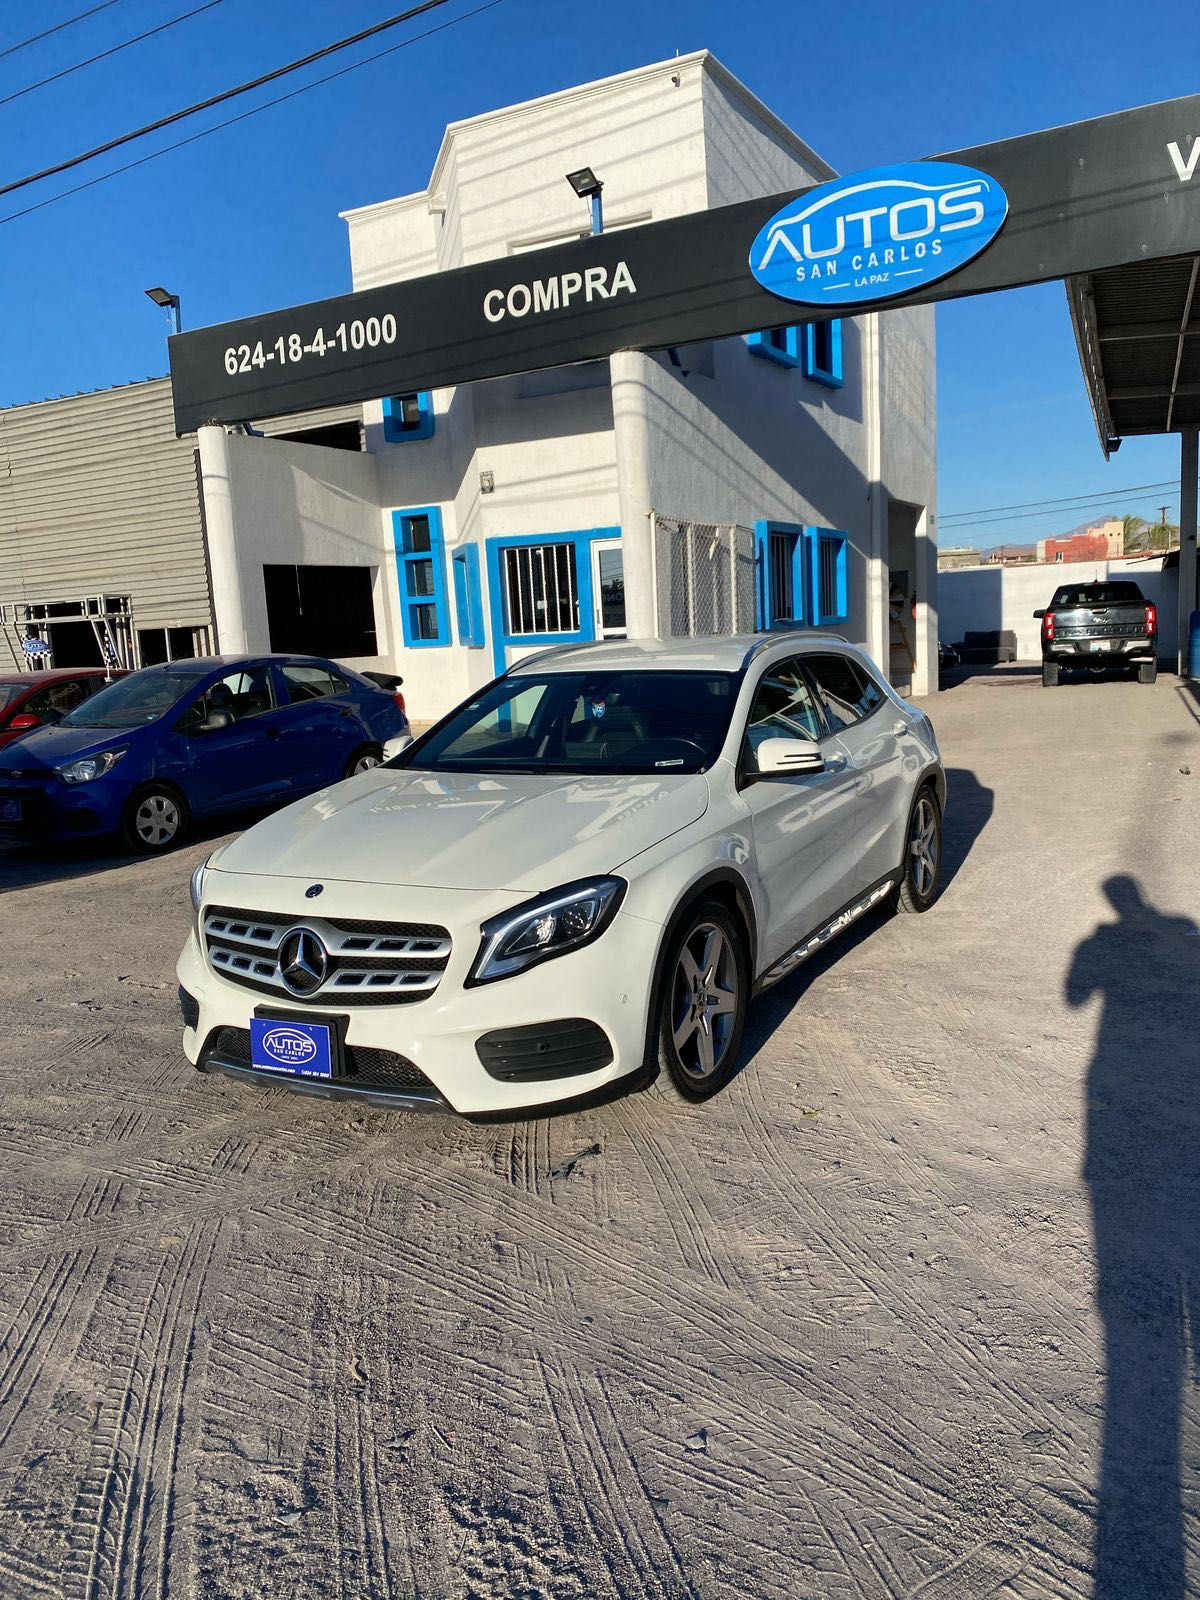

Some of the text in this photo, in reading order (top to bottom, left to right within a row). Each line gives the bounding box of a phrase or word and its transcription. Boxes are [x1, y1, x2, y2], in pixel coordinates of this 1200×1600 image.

[1167, 136, 1200, 182] V
[758, 185, 985, 270] AUTOS
[796, 239, 943, 282] SAN CARLOS
[854, 272, 890, 288] LA PAZ
[483, 261, 637, 323] COMPRA
[223, 313, 397, 376] 624-18-4-1000
[266, 1037, 312, 1053] AUTOS
